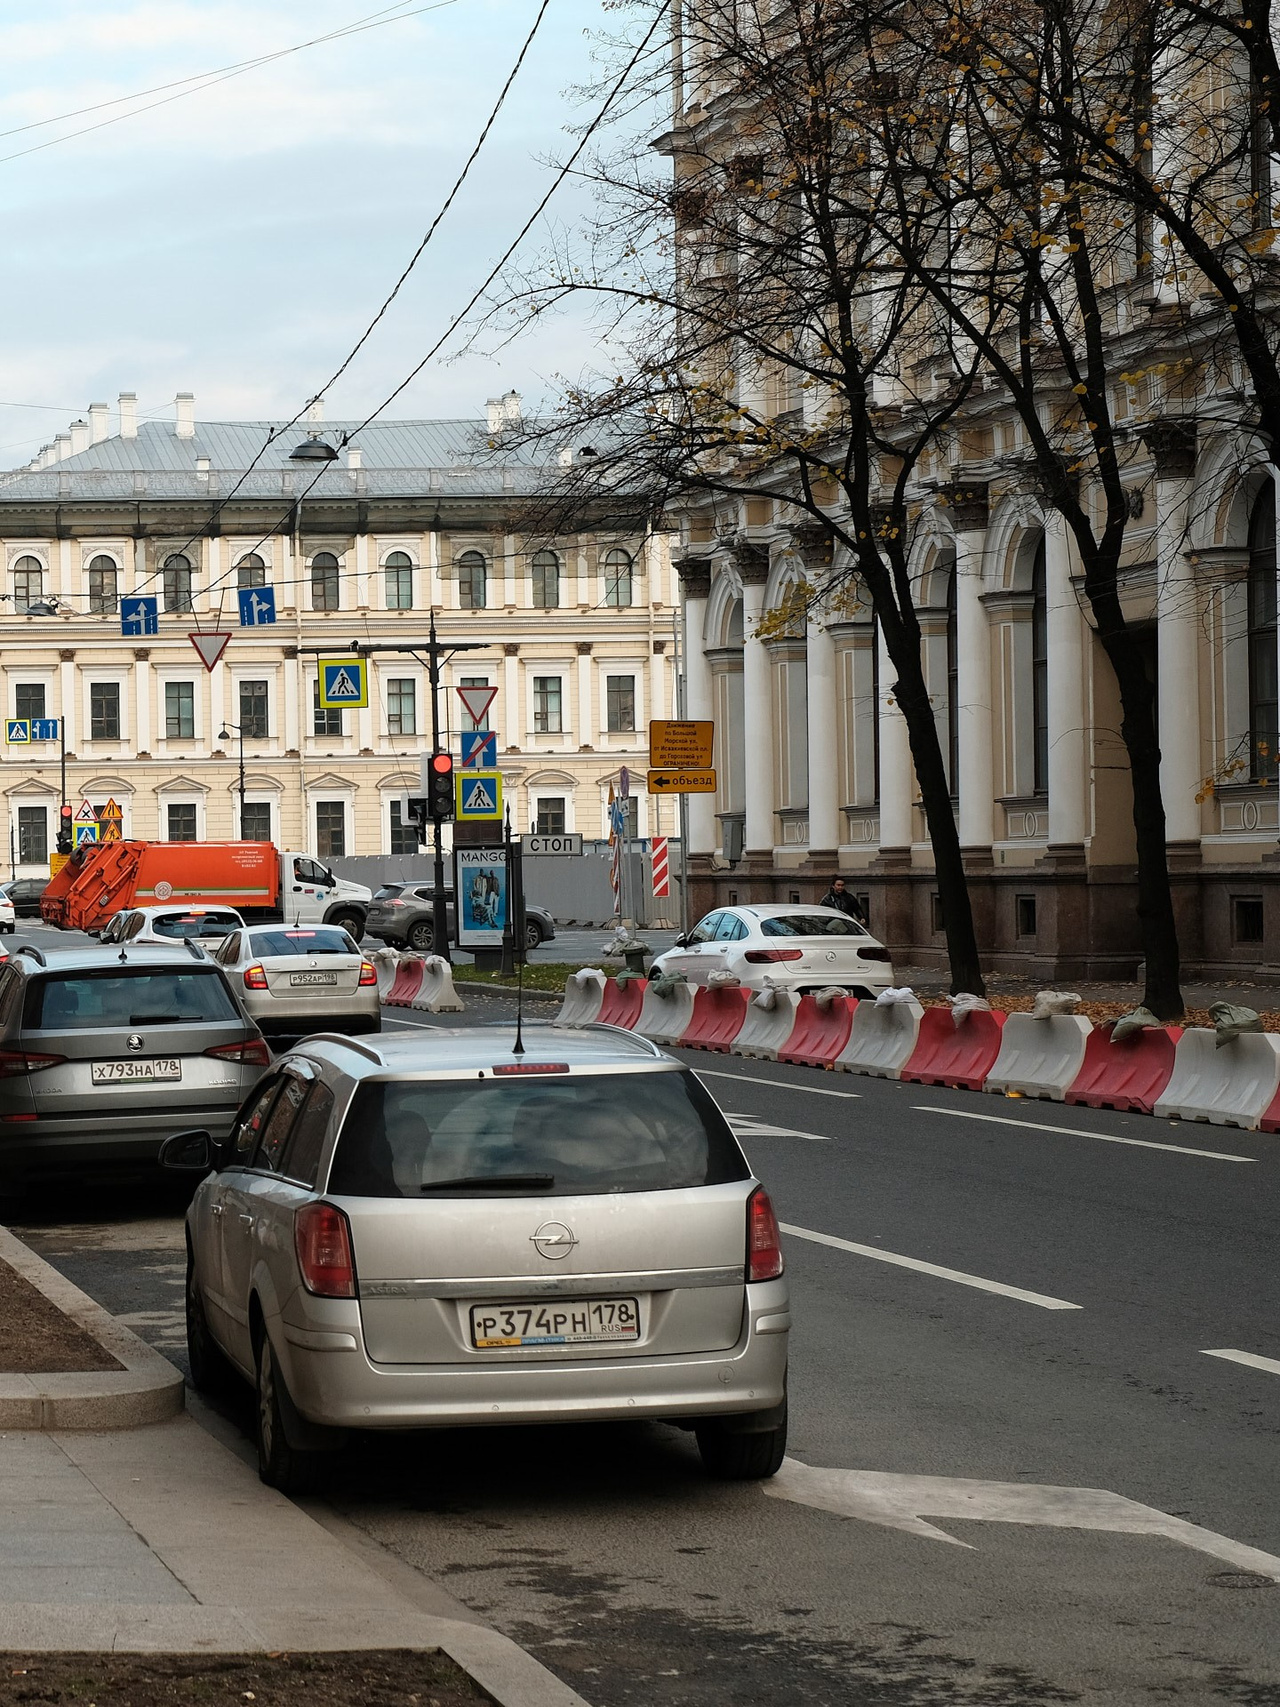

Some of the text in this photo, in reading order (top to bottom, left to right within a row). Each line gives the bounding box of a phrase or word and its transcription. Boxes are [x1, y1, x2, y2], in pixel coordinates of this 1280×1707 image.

[672, 775, 713, 785] объезд
[530, 838, 573, 852] СТОП
[155, 1060, 176, 1072] 178
[482, 1303, 631, 1338] Р374РН 178
[601, 1324, 621, 1332] RUS
